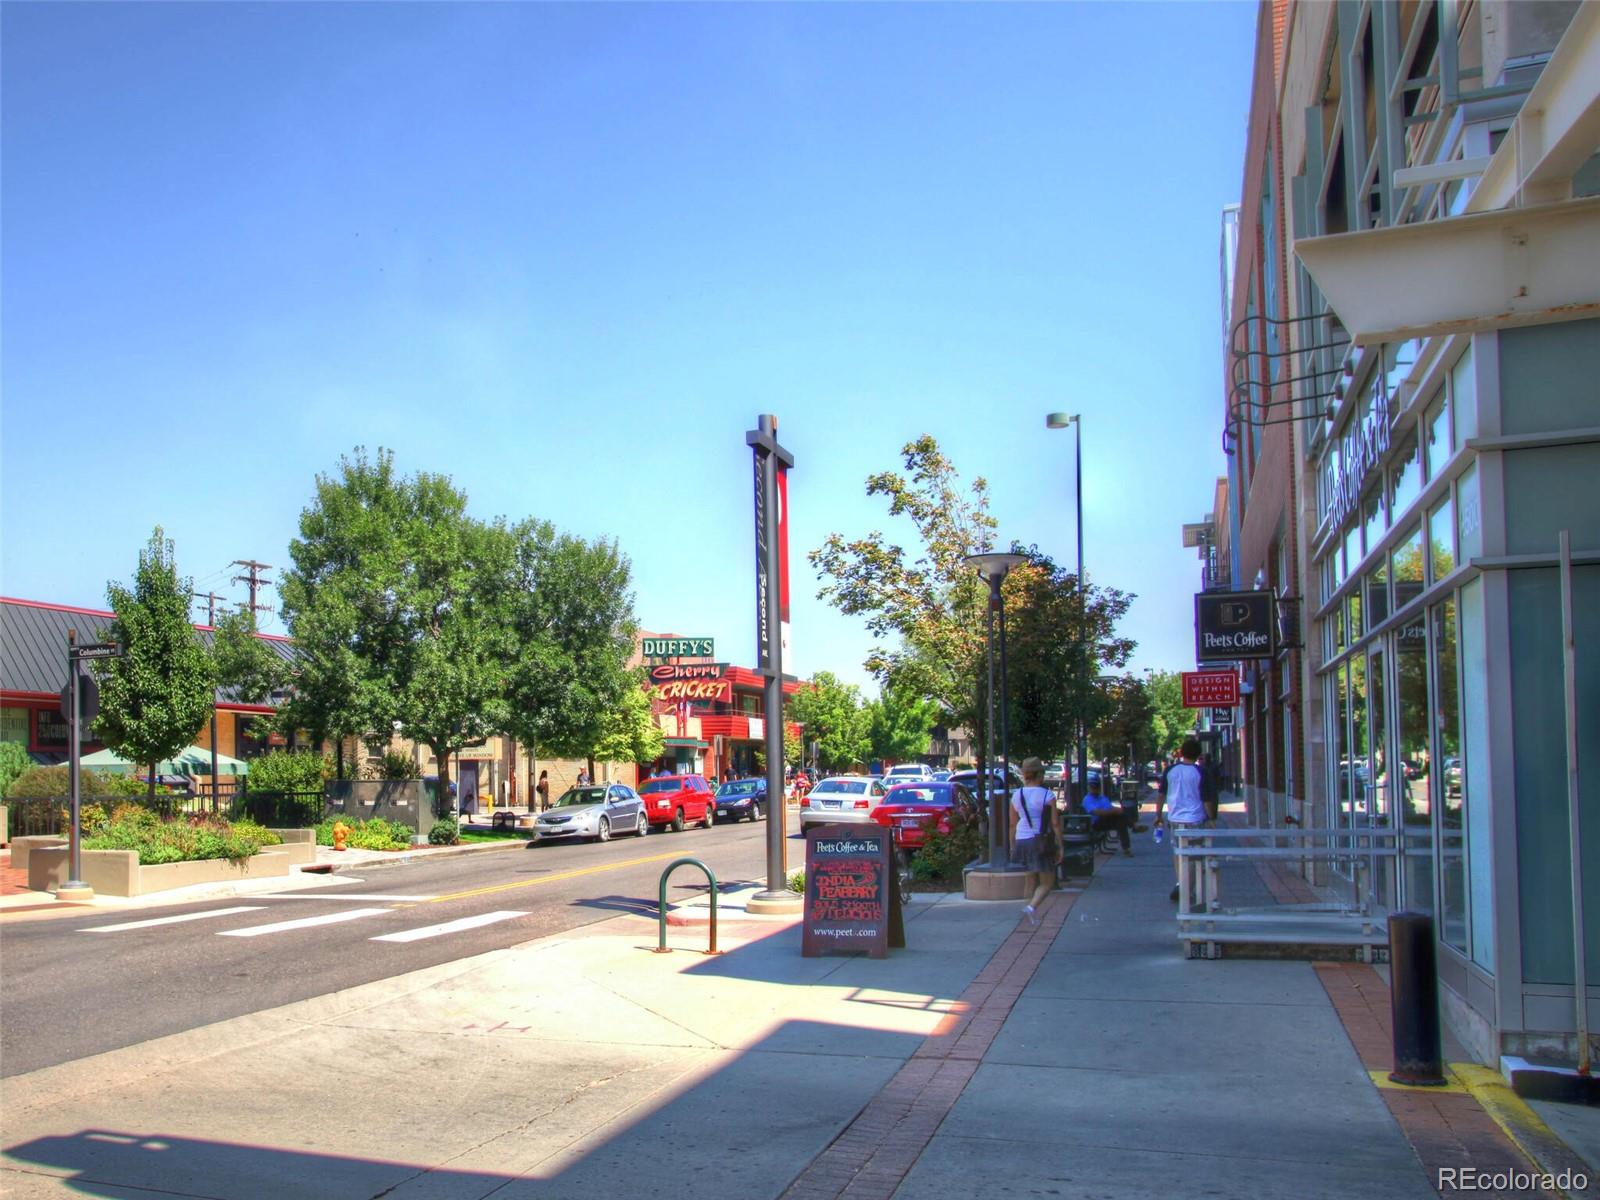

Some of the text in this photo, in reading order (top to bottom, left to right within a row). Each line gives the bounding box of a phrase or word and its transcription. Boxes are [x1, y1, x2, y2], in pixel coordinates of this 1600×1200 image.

[760, 573, 769, 642] Second
[1233, 631, 1268, 648] Coffee
[79, 647, 110, 656] Columbine
[644, 640, 713, 655] DUFFY'S
[652, 665, 720, 679] Cherry
[1191, 677, 1230, 685] DESIGN
[660, 680, 728, 700] CRICKET
[835, 841, 858, 854] Coffee
[864, 841, 879, 852] Tea
